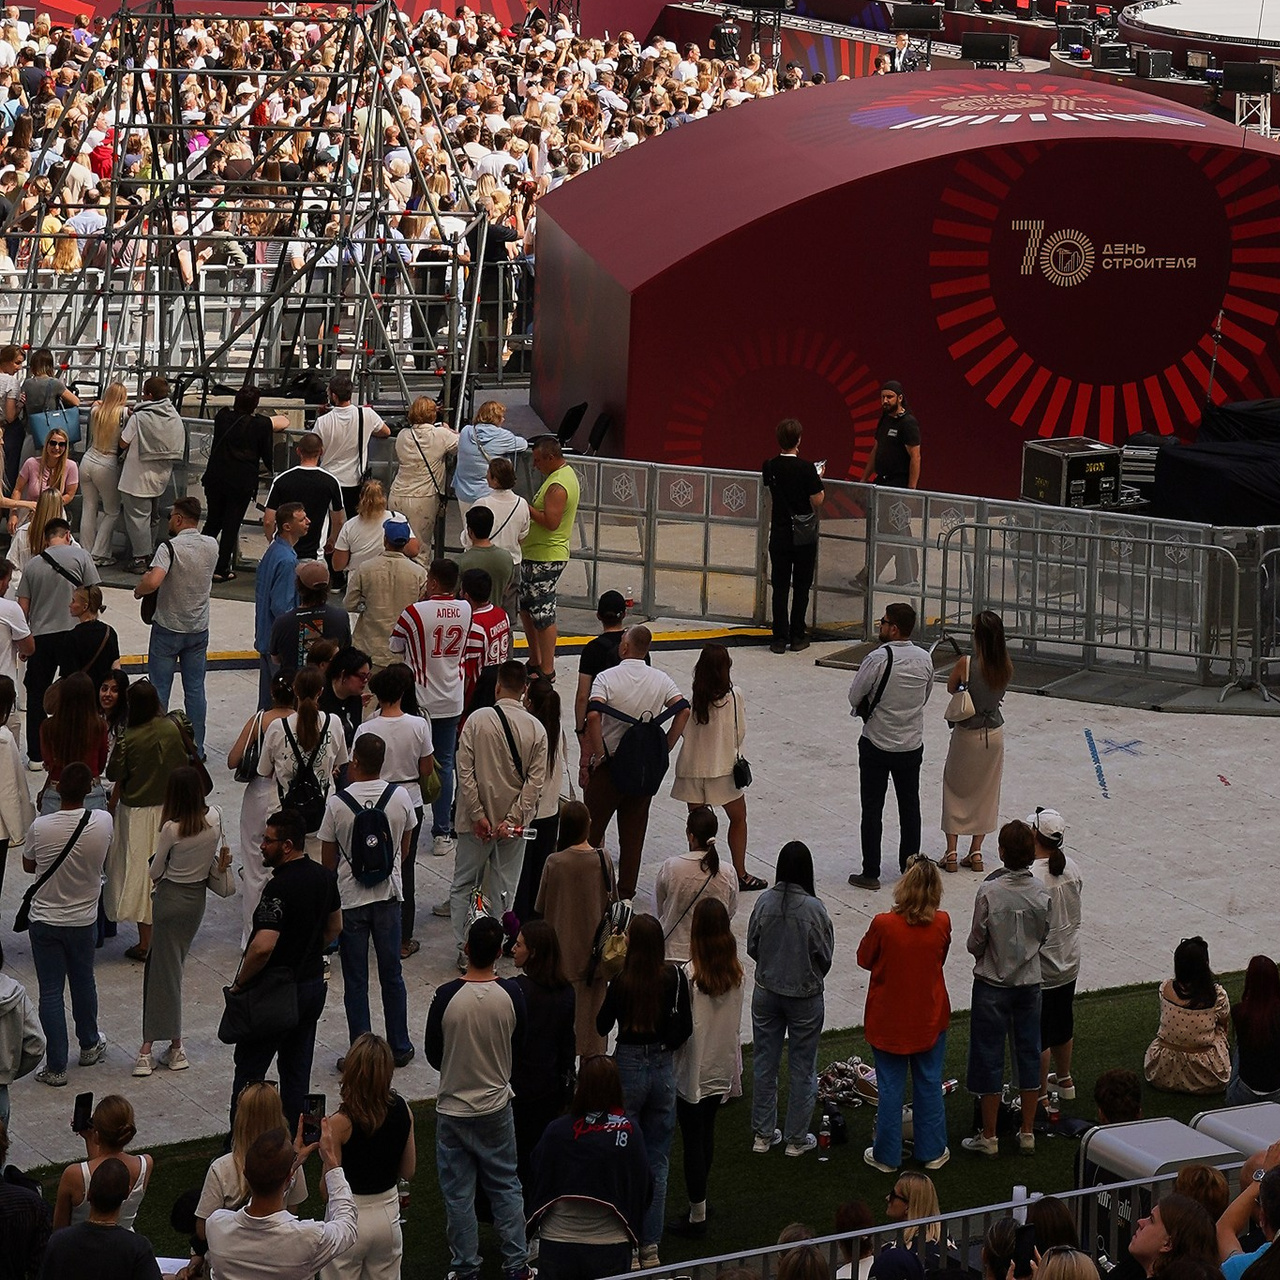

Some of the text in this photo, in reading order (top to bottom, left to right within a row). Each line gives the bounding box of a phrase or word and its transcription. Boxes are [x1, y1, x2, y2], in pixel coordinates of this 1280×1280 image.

[1102, 243, 1146, 255] ДЕНЬ
[1102, 257, 1197, 270] СТРОИТЕЛЯ
[436, 608, 461, 619] АЛЕКС
[431, 625, 464, 658] 12
[615, 1130, 628, 1147] 18
